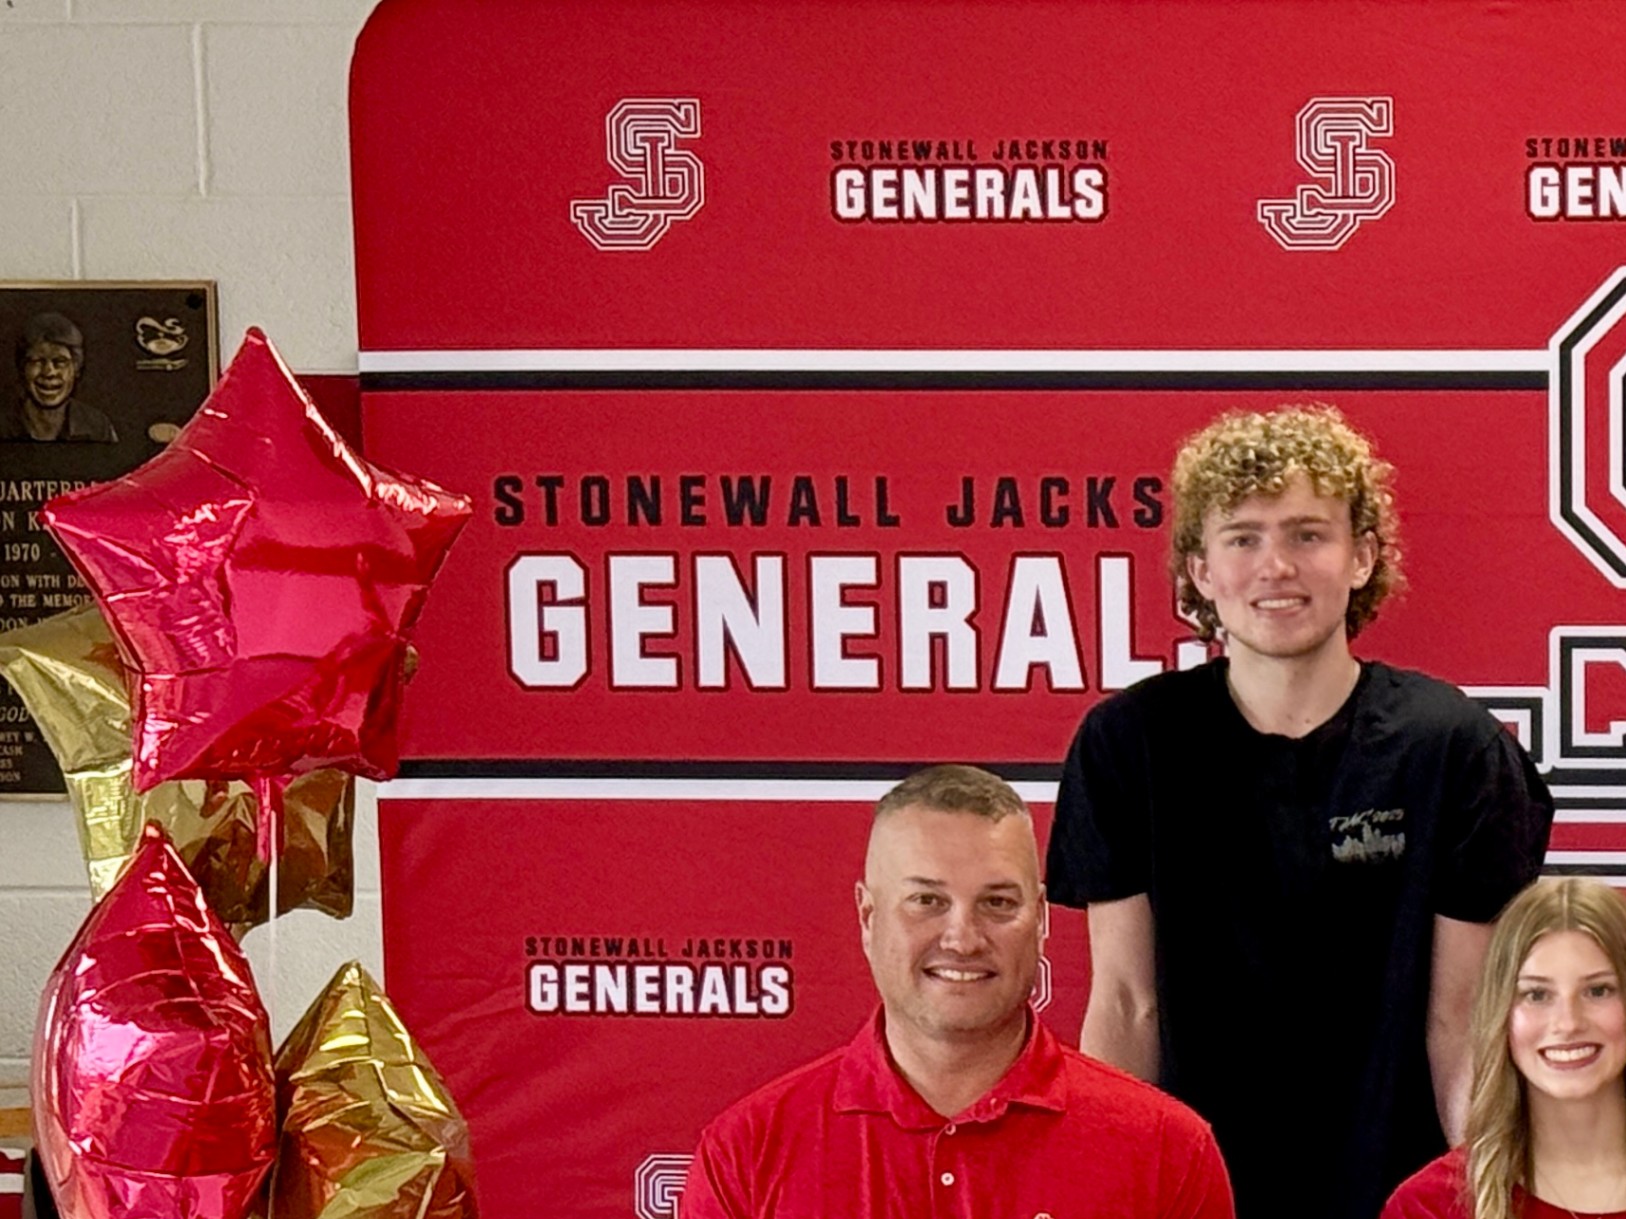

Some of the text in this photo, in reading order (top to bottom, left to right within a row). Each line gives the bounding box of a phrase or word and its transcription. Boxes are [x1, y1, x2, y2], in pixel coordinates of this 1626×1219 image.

[830, 139, 1109, 161] STONEWALL JACKSON
[831, 164, 1108, 222] GENERALS
[493, 474, 1164, 530] STONEWALL JACKS
[4, 543, 40, 561] 1970
[26, 574, 60, 589] WITH
[9, 594, 36, 608] THE
[504, 551, 1230, 692] GENERAL
[525, 937, 792, 958] STONEWALL JACKSON
[528, 961, 793, 1017] GENERALS
